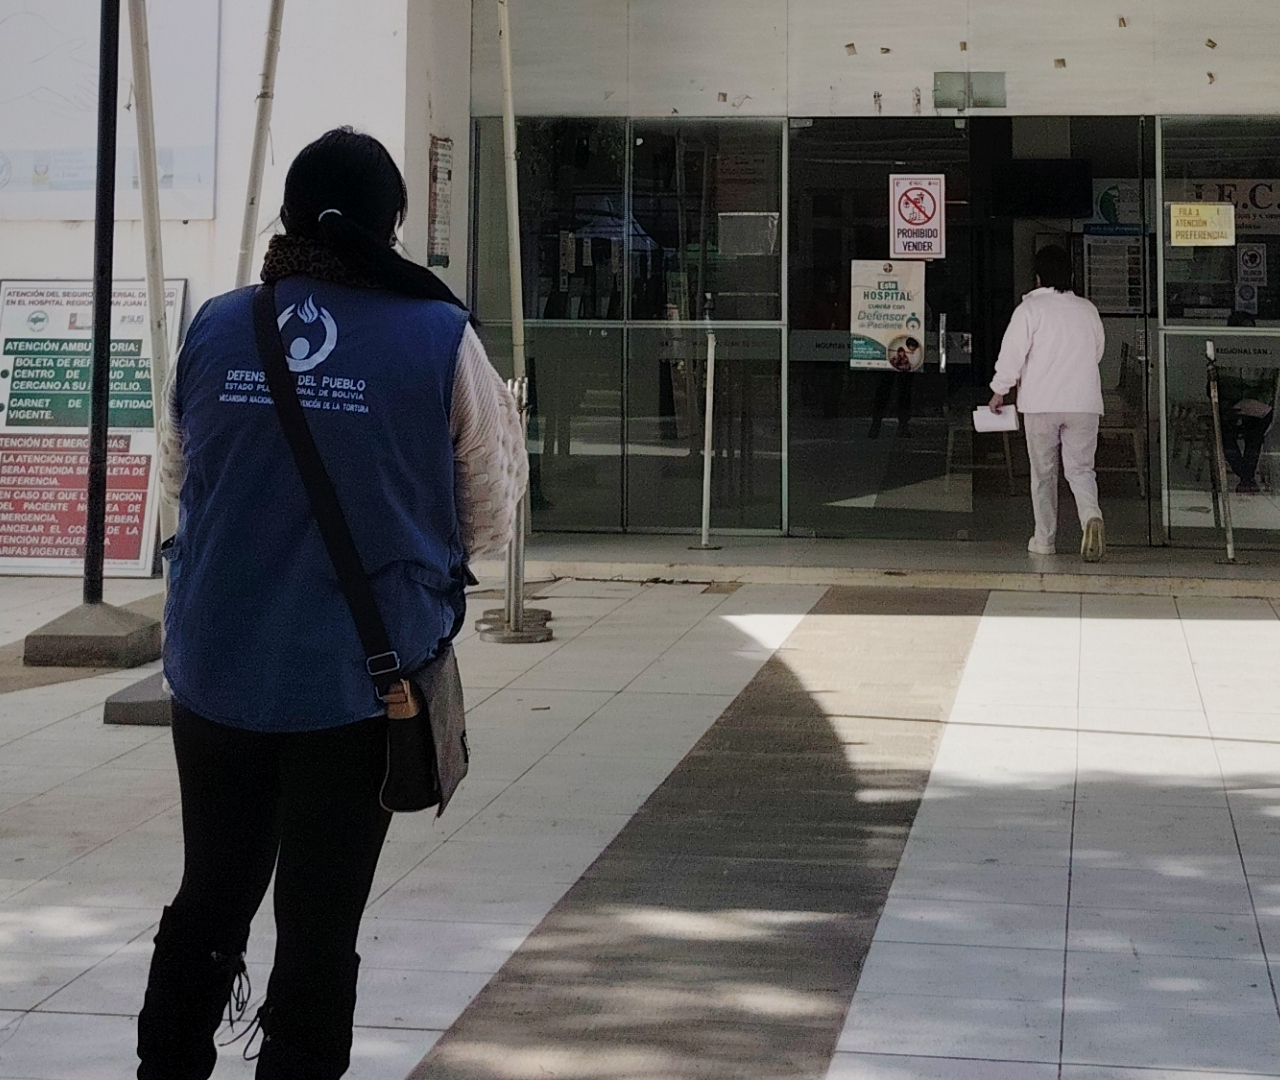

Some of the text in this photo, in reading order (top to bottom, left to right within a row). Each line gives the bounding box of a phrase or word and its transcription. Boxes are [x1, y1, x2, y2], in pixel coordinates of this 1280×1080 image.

[1176, 219, 1207, 227] ATENCIÓN
[897, 228, 938, 239] PROHIBIDO
[1176, 230, 1228, 239] PREFERENCIAL
[902, 241, 932, 252] VENDER
[864, 291, 912, 301] HOSPITAL
[857, 310, 907, 321] Defensor
[5, 342, 138, 351] ATENCIÓN AMBUORIA:
[16, 359, 54, 367] BOLETA
[73, 359, 135, 368] REFNCIA
[14, 370, 54, 379] CENTRO
[66, 370, 79, 378] DE
[13, 381, 61, 390] CERCANO
[62, 381, 70, 389] A
[72, 382, 86, 390] SU
[297, 375, 317, 387] DEL
[322, 376, 366, 391] PUEBLO
[225, 382, 253, 391] ESTADO
[332, 390, 364, 400] BOLIVIA
[10, 399, 50, 408] CARNET
[343, 403, 369, 413] TORTURA
[8, 411, 54, 419] VIGENTE.
[57, 439, 127, 448] EMERGIAS:
[16, 454, 63, 463] ATENCIÓN
[65, 456, 78, 464] DE
[28, 466, 74, 474] ATENDIDA
[14, 491, 39, 500] CASO
[58, 492, 77, 500] QUE
[80, 492, 88, 500] L
[106, 491, 142, 501] ENCIÓN
[24, 503, 68, 511] PACIENTE
[128, 504, 141, 512] DE
[126, 526, 138, 534] LA
[30, 547, 79, 556] VIGENTES.
